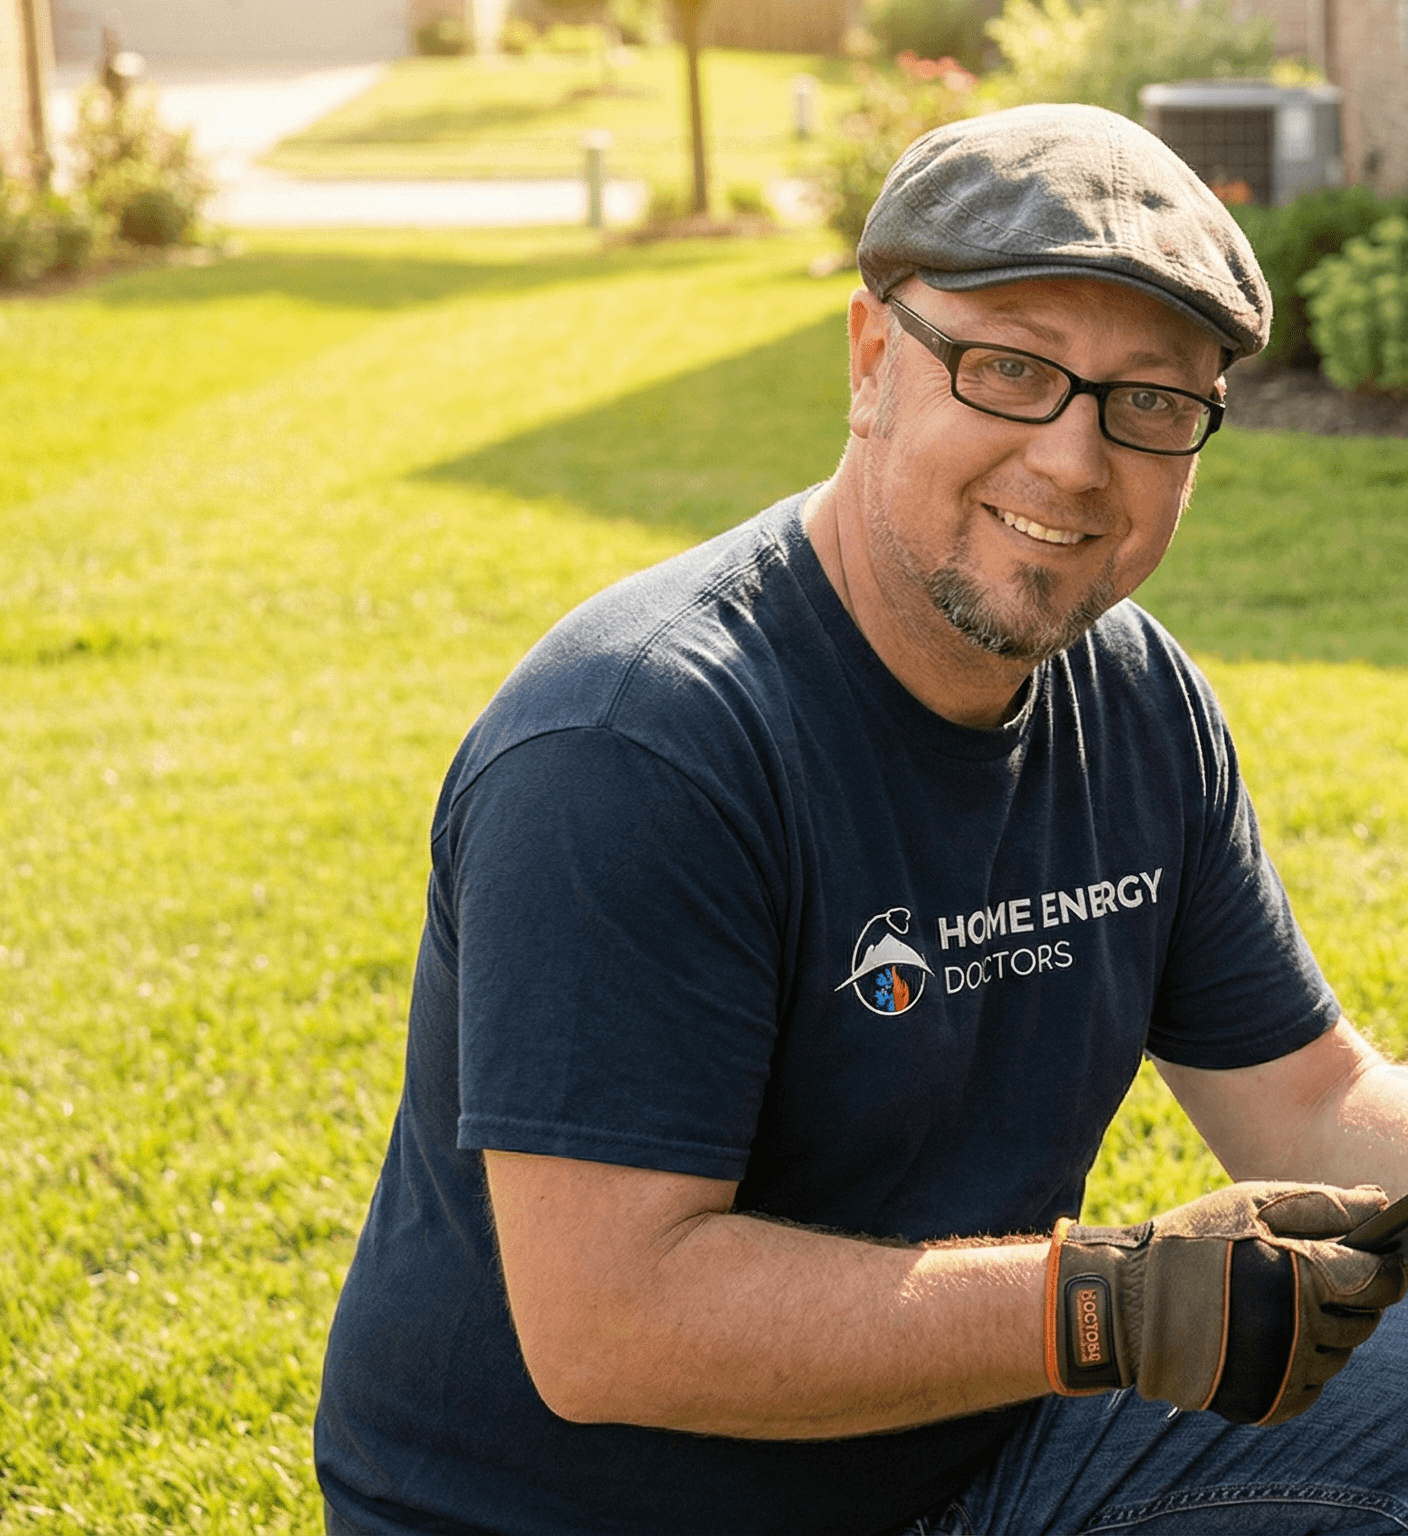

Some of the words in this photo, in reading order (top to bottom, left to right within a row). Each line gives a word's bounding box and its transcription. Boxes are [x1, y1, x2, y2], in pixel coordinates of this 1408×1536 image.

[938, 898, 1034, 950] HOME
[1041, 867, 1163, 929] ENERGY
[944, 940, 1073, 995] DOCTORS
